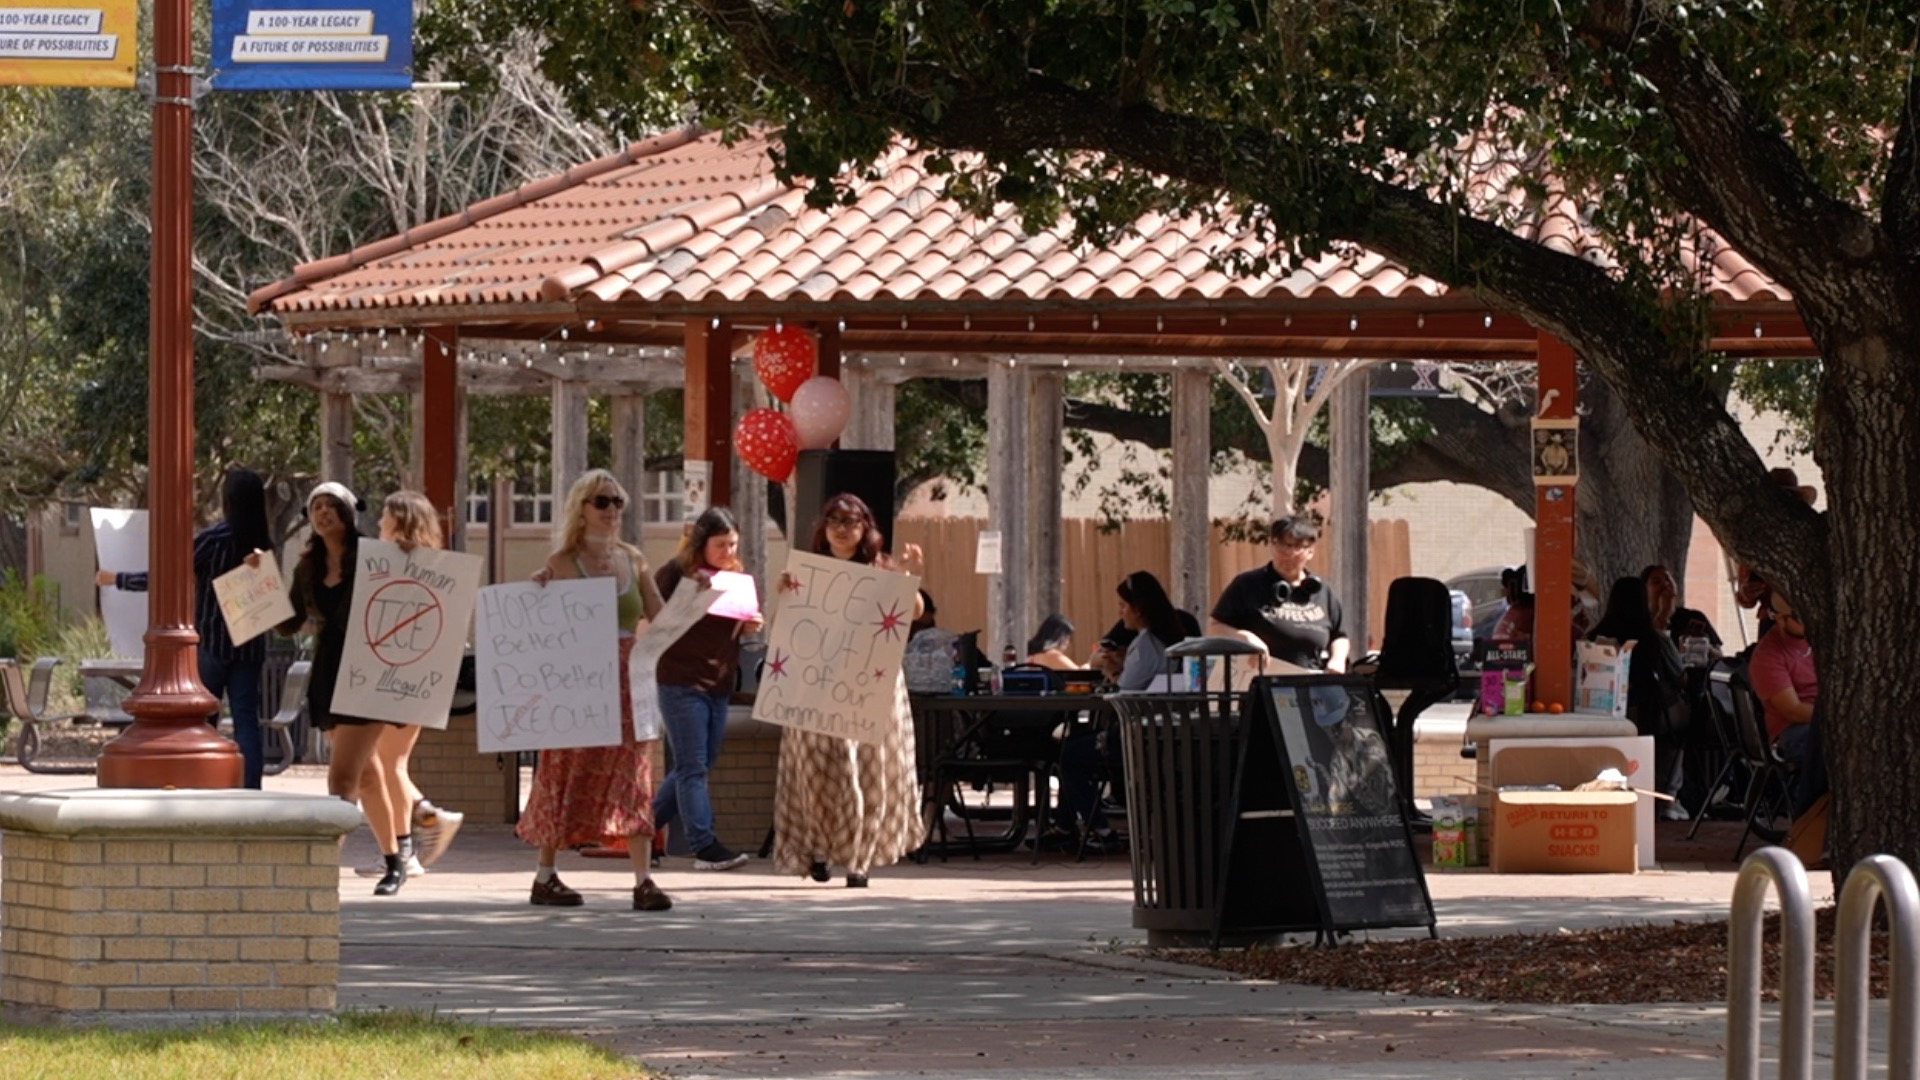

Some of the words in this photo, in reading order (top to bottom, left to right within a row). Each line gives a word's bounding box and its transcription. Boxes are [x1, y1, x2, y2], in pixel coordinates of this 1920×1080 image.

[0, 14, 49, 25] 100-YEAR
[52, 15, 90, 25] LEGACY
[258, 17, 265, 27] A
[269, 16, 318, 27] 100-YEAR
[321, 16, 361, 27] LEGACY
[22, 40, 35, 50] OF
[38, 40, 109, 51] POSSIBILITIES
[240, 42, 247, 52] A
[251, 41, 289, 52] FUTURE
[292, 41, 305, 52] OF
[308, 41, 379, 52] POSSIBILITIES
[404, 553, 456, 594] human
[788, 563, 877, 626] ICE
[483, 589, 556, 632] HOPE
[365, 598, 432, 652] ICE
[496, 704, 549, 735] ICE
[1541, 810, 1588, 820] RETURN
[1593, 810, 1608, 820] TO
[1548, 844, 1600, 857] SNACKS!
